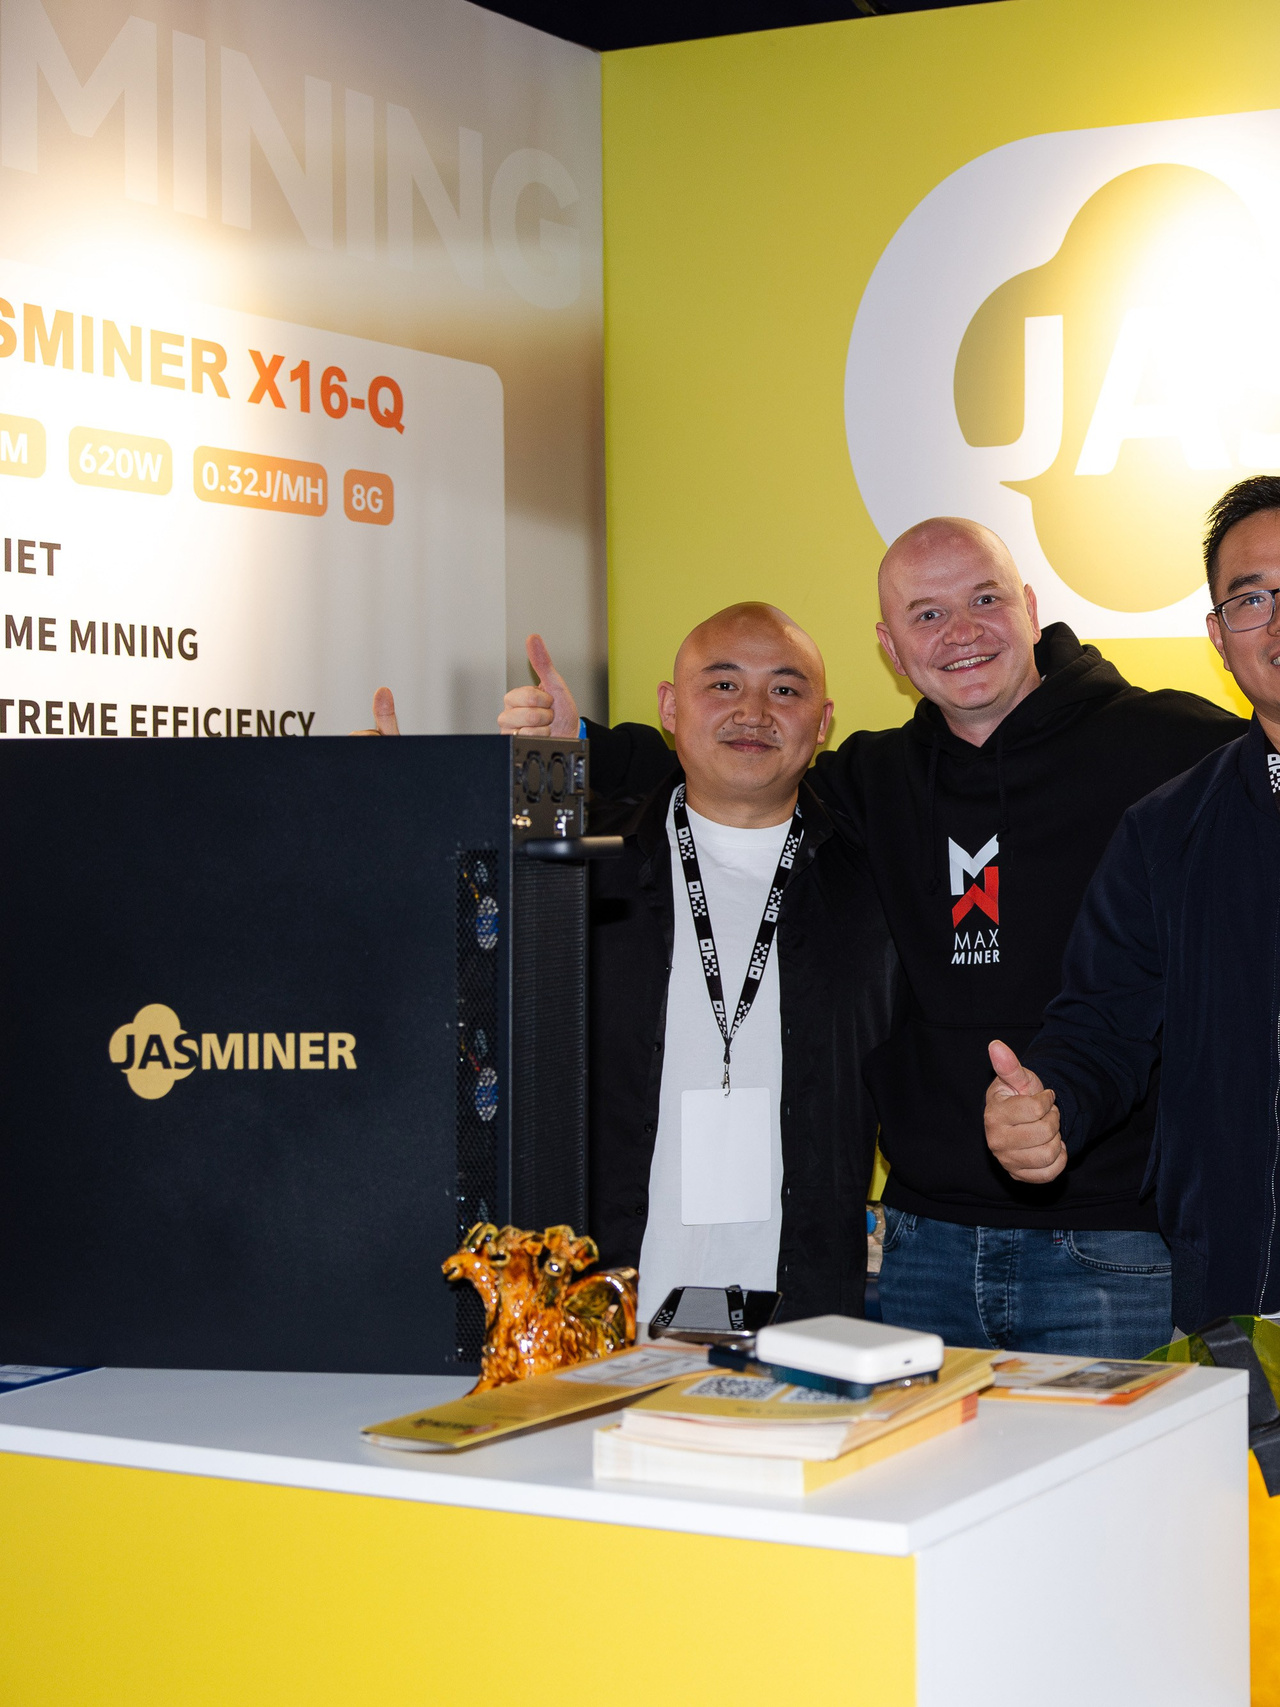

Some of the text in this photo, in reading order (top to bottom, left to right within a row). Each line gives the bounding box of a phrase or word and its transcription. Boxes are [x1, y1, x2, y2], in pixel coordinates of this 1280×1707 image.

[0, 0, 580, 310] MINING
[247, 349, 405, 434] X16-Q
[79, 442, 163, 483] 620W
[202, 461, 324, 506] 0.32J/MH
[351, 484, 385, 514] 8G
[4, 537, 61, 576] IET
[5, 614, 199, 661] ME MINING
[0, 698, 315, 738] TREME EFFICIENCY
[951, 950, 1000, 965] MINER
[954, 929, 999, 951] MAX
[112, 1032, 358, 1070] JASMINER
